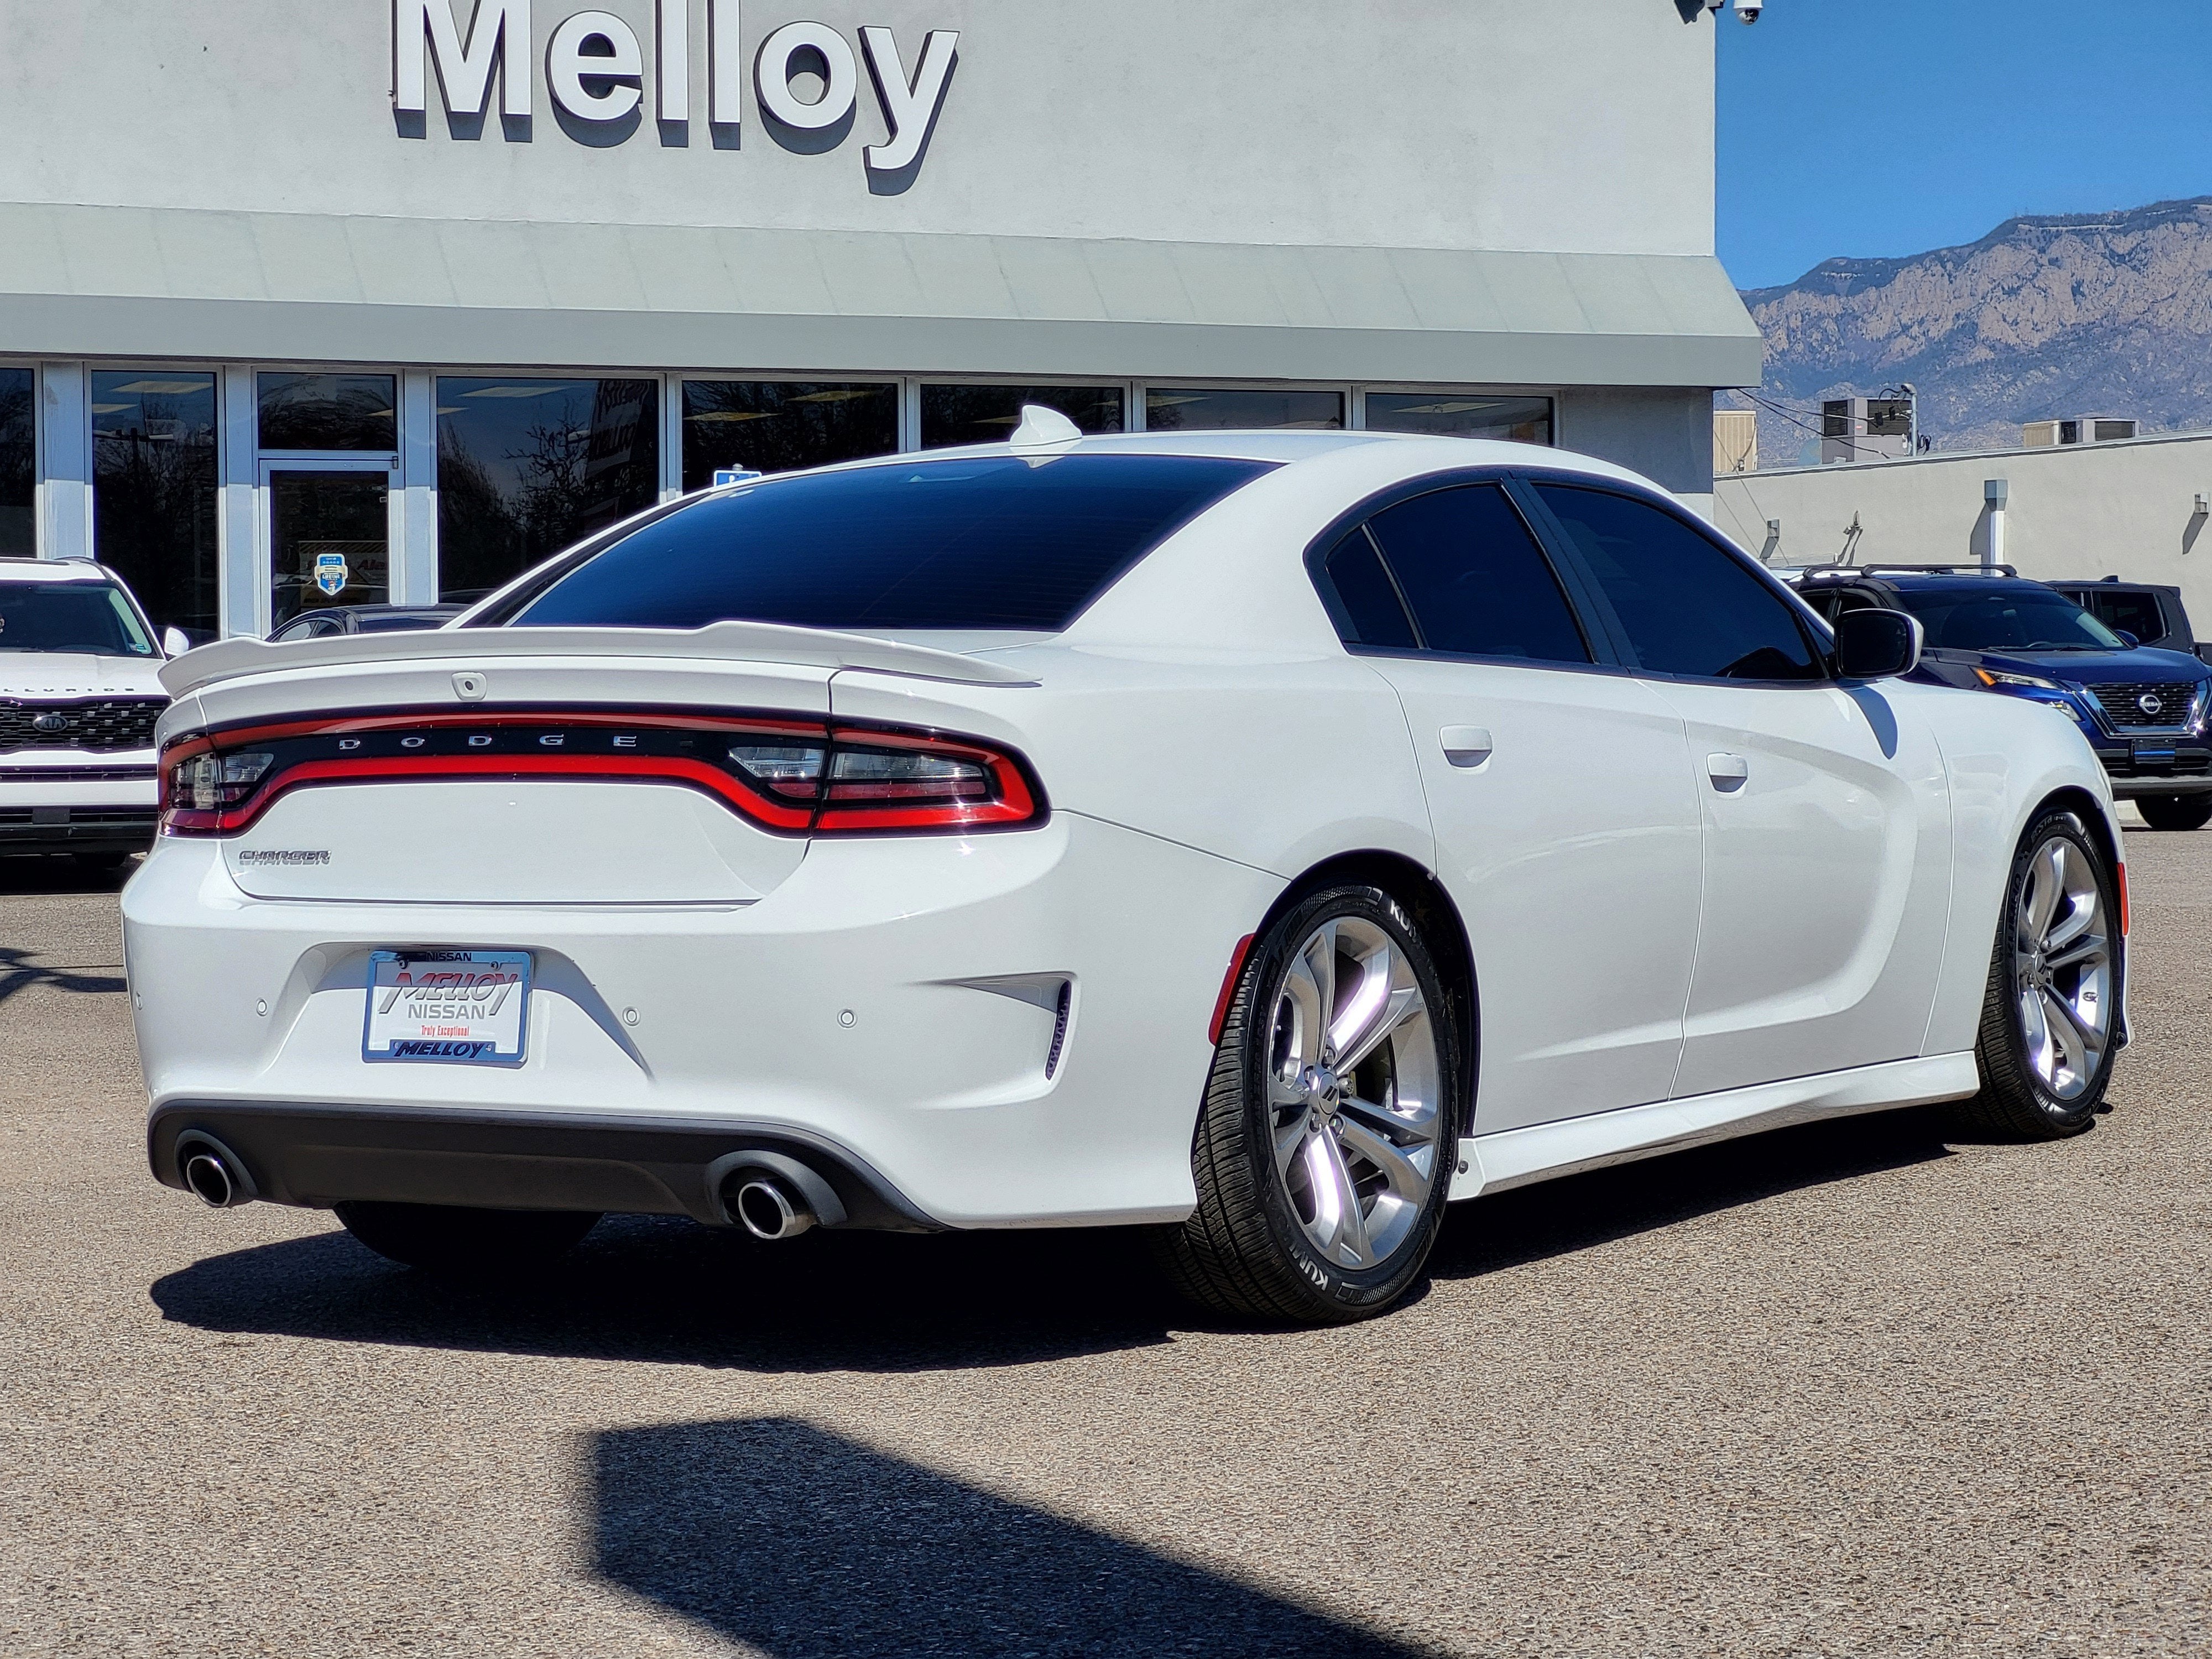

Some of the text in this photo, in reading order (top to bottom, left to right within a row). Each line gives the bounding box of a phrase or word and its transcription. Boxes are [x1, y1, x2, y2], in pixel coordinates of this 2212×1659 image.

[394, 0, 961, 170] Melloy
[39, 717, 63, 729] KIA
[339, 734, 637, 750] DODGE
[239, 851, 331, 860] CHARGER
[426, 952, 472, 962] NISSAN
[378, 972, 518, 1016] MELLOY
[408, 1004, 485, 1019] NISSAN
[421, 1025, 469, 1037] Truly Exceptional
[394, 1041, 485, 1058] MELLOY
